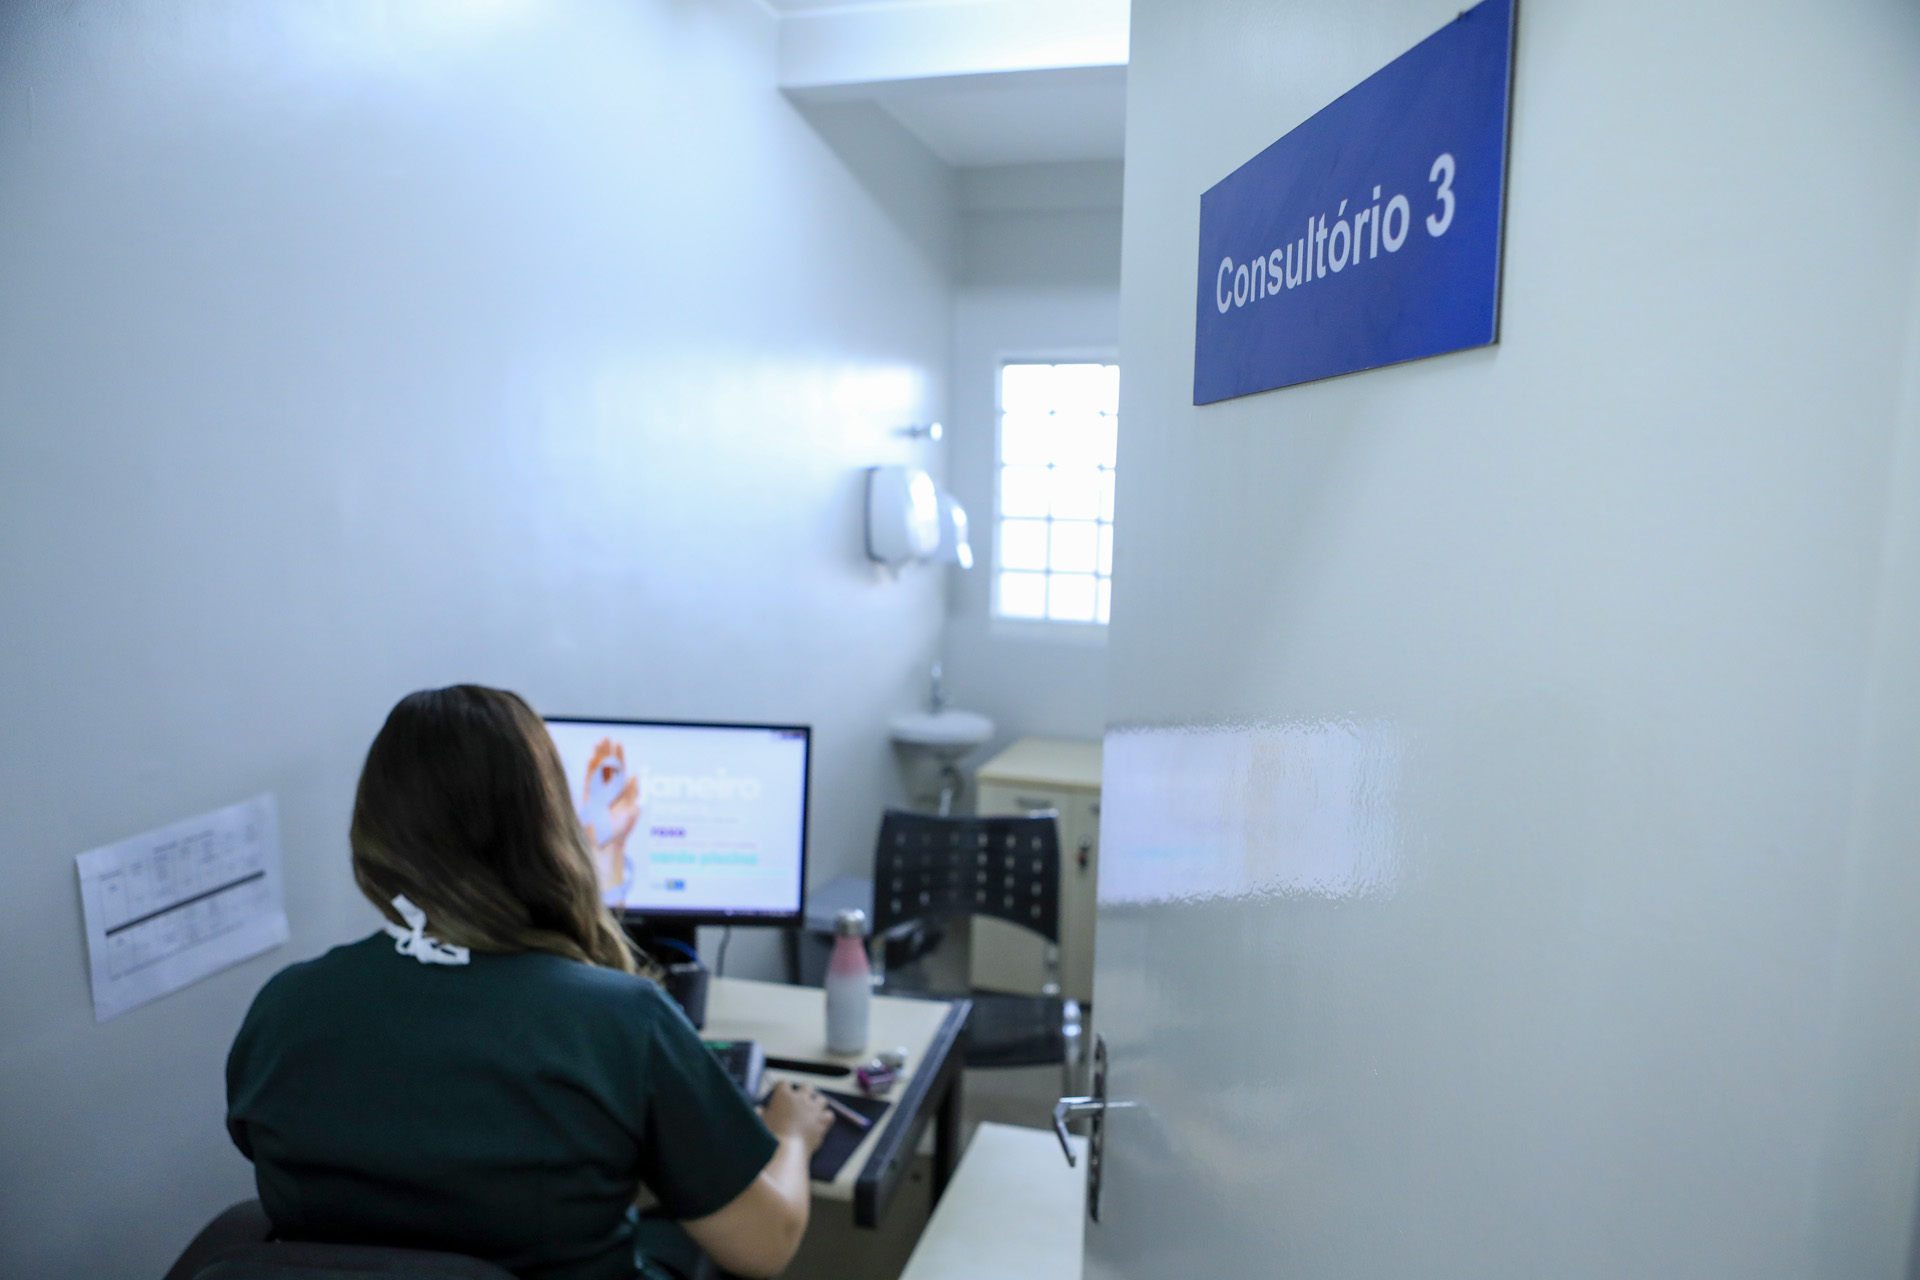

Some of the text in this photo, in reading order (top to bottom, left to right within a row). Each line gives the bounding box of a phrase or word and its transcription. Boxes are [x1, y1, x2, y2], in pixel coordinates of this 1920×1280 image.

[1216, 153, 1456, 314] Consultório 3
[639, 765, 763, 805] janeiro
